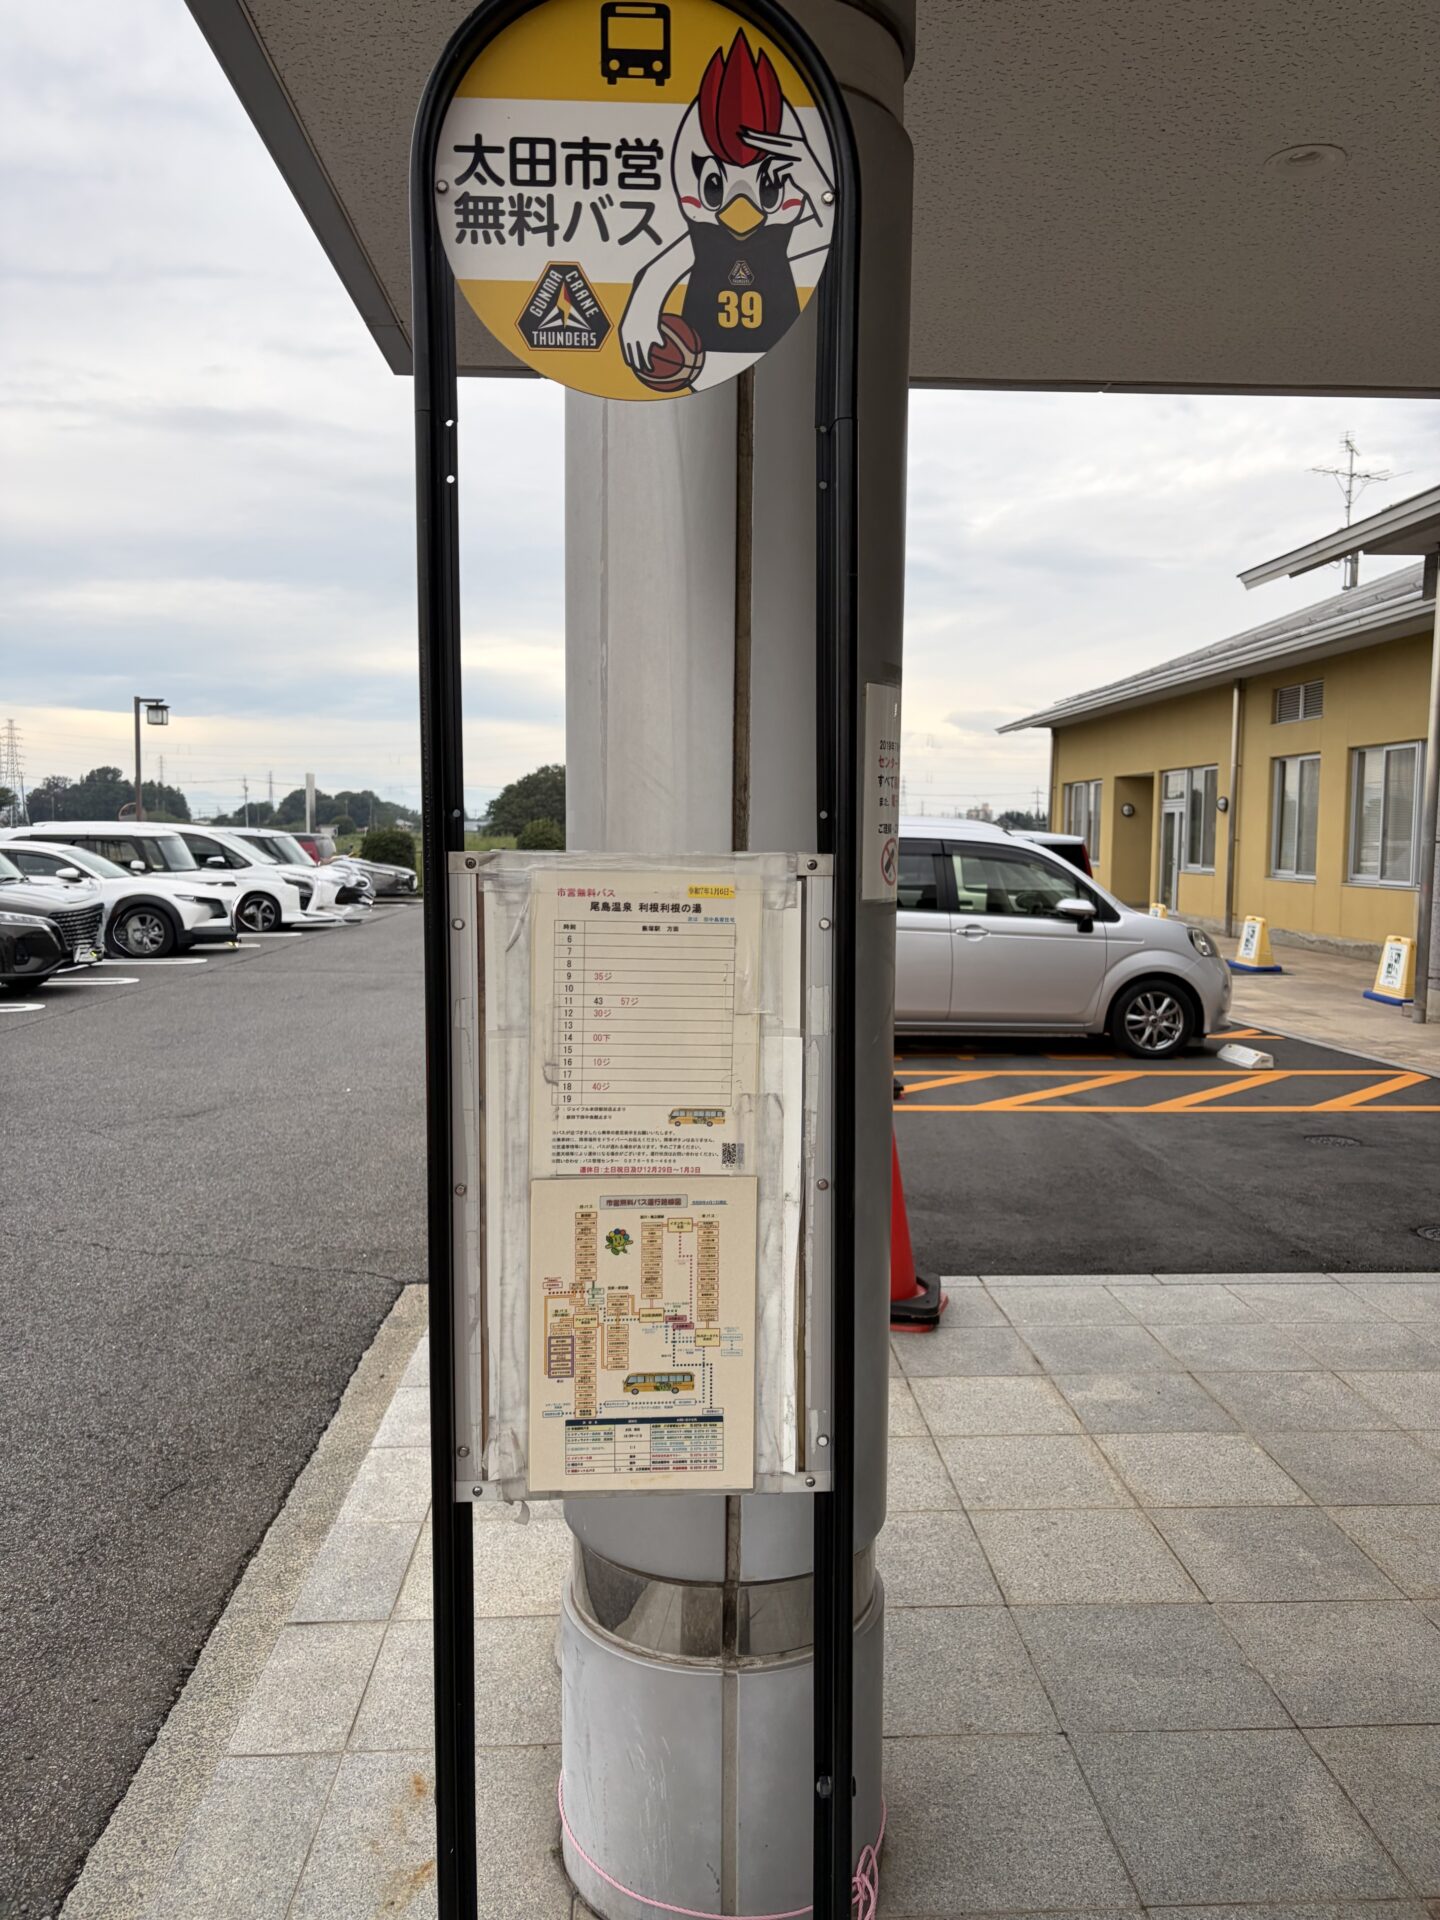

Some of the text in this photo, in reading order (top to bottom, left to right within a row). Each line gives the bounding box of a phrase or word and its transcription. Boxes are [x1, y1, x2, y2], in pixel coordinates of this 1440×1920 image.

[453, 133, 664, 191] 太田市営
[454, 191, 663, 247] 無料バス
[529, 270, 563, 317] GUNMA
[565, 270, 599, 318] CRANE
[717, 290, 763, 329] 39
[532, 331, 597, 346] THUNDERS
[557, 888, 616, 898] 市営無料バス
[590, 901, 702, 914] 尾島温泉 利根利根の湯
[566, 960, 572, 968] 8
[594, 972, 612, 981] 35ジ
[621, 998, 639, 1006] 57ジ
[564, 1009, 573, 1017] 12
[563, 1058, 572, 1066] 16
[592, 1082, 610, 1091] 40ジ
[562, 1095, 572, 1103] 19
